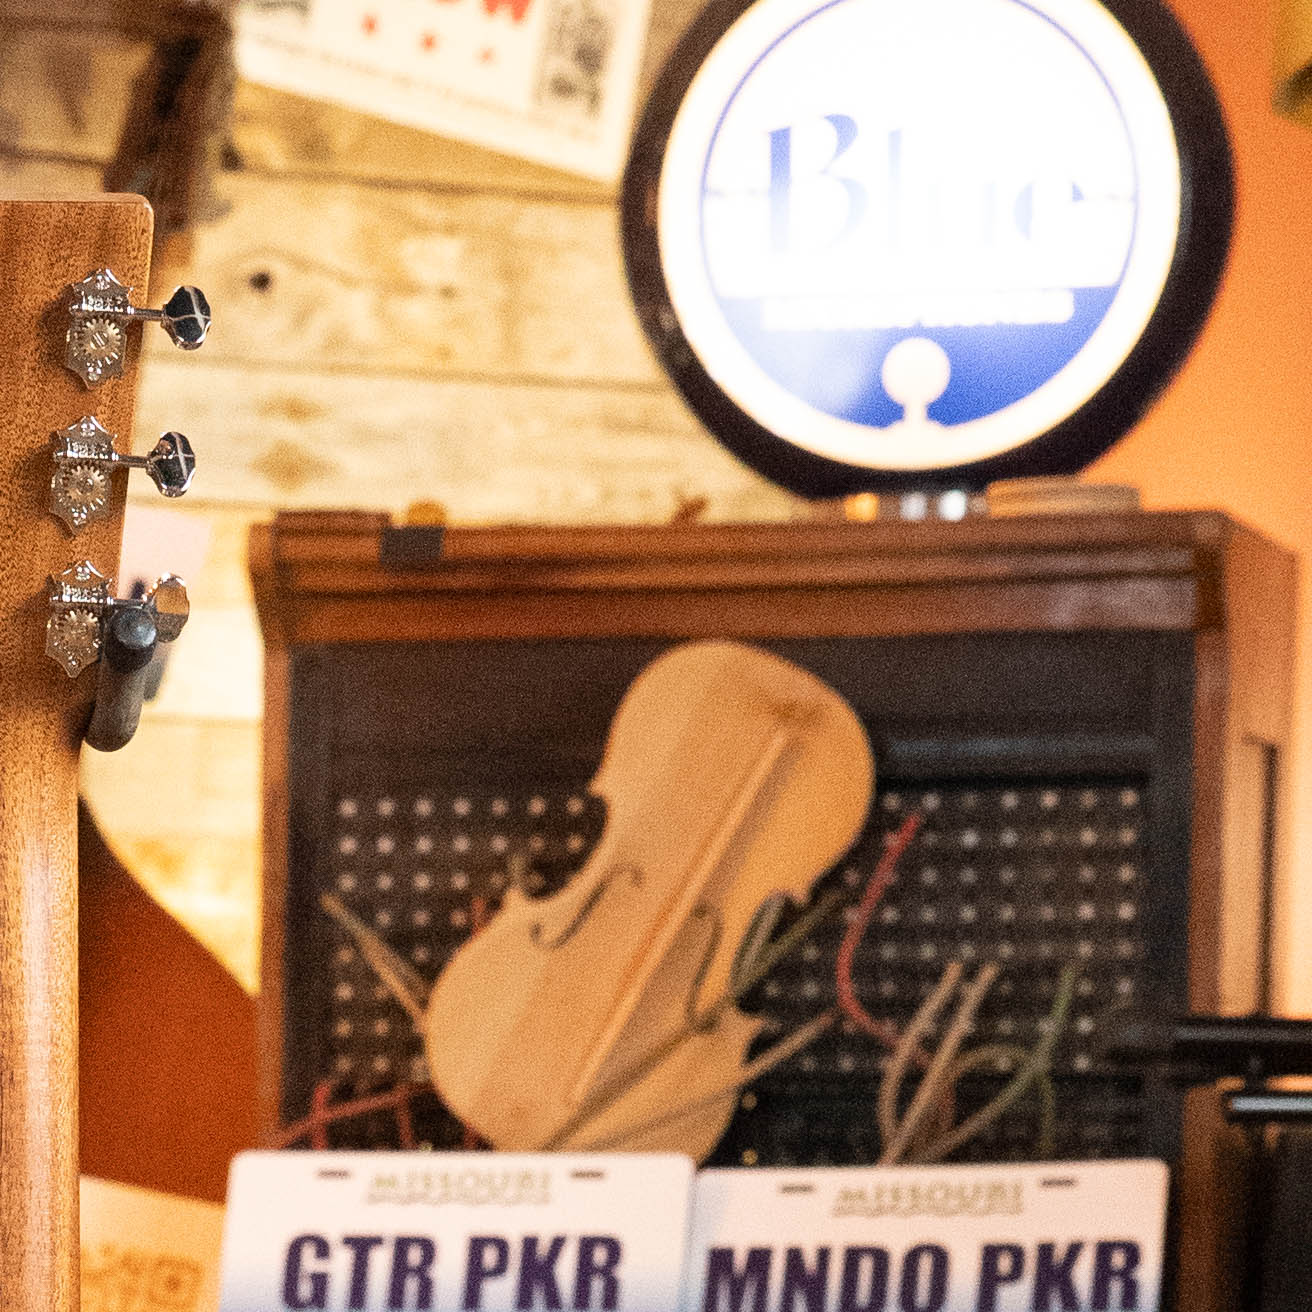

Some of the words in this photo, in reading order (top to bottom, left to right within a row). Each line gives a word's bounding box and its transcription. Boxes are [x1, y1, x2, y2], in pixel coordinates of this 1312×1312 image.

[365, 1169, 552, 1207] MISSOURI
[830, 1179, 1027, 1219] MISSOURI
[280, 1233, 438, 1312] GTR
[459, 1233, 625, 1312] PKR
